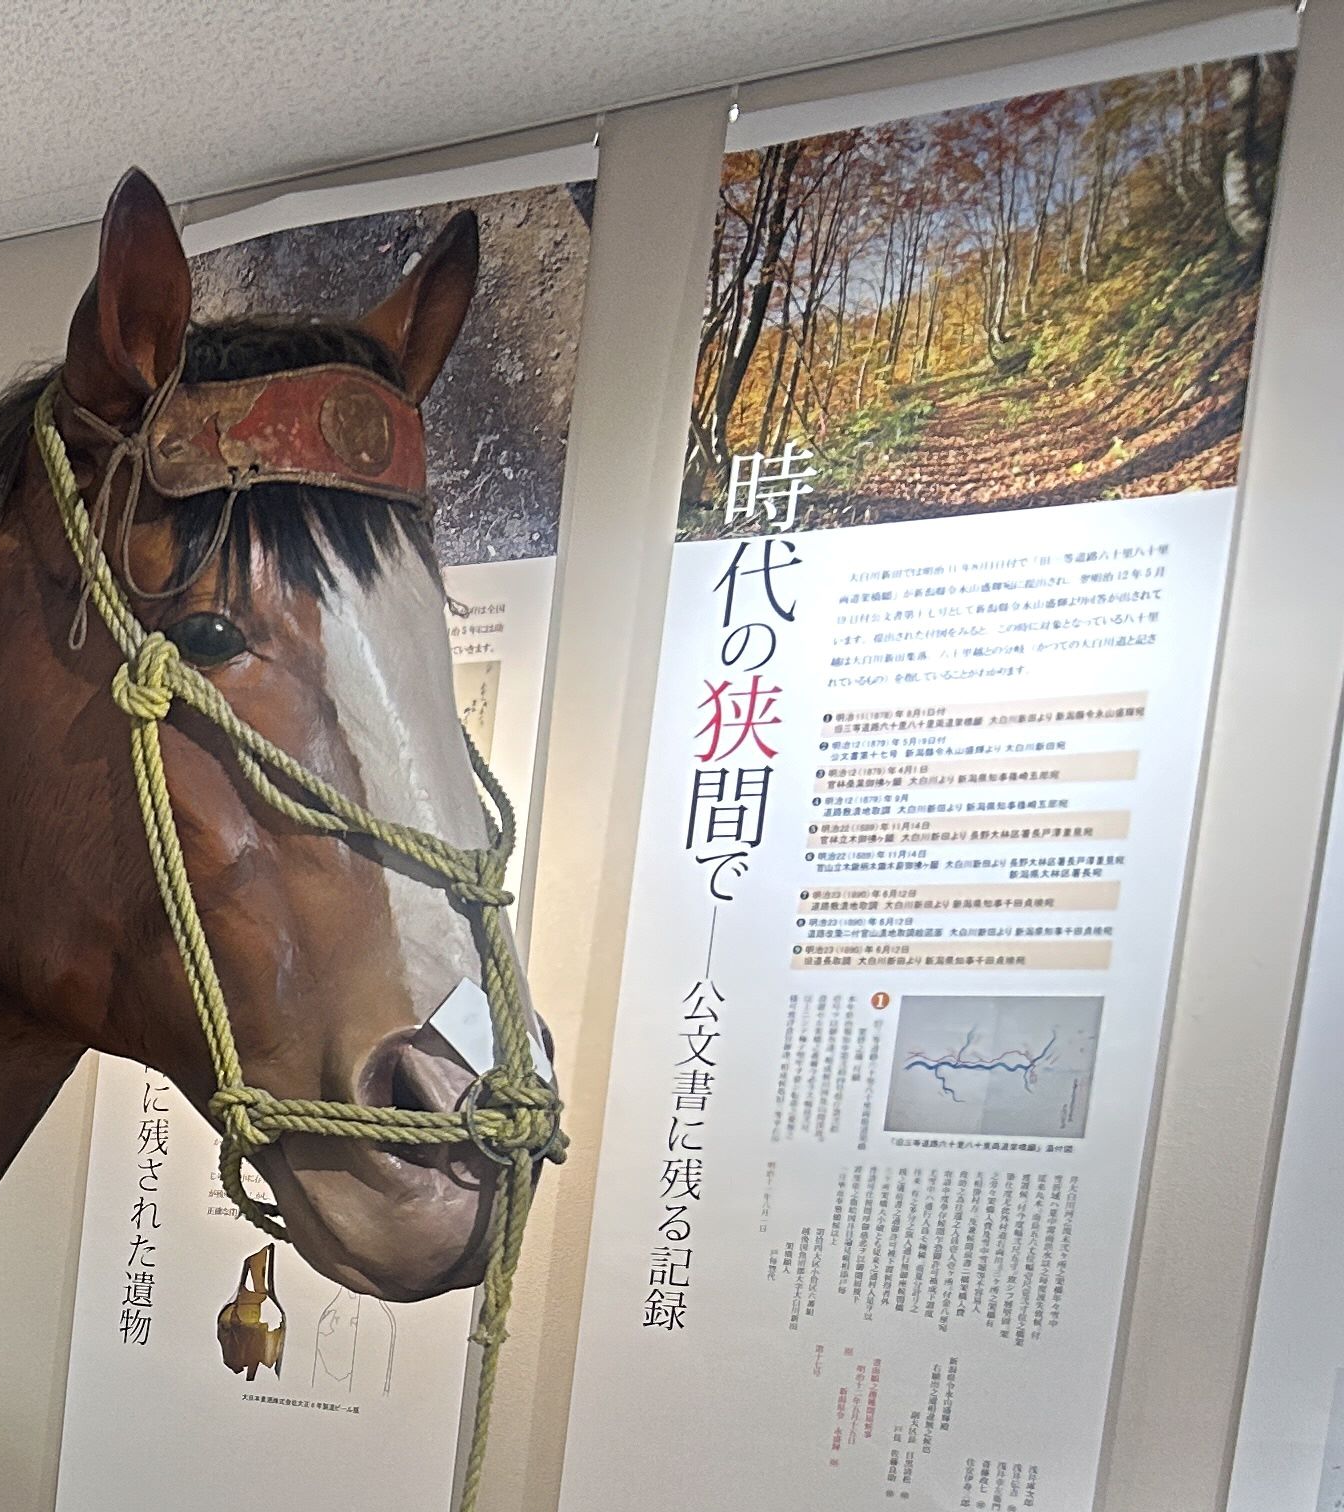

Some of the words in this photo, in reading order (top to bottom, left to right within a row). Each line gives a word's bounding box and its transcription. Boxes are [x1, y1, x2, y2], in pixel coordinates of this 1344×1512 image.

[686, 446, 819, 901] 時代の狭間で
[119, 1065, 170, 1345] に残された遺物
[643, 979, 725, 1332] 公文書に残る記録
